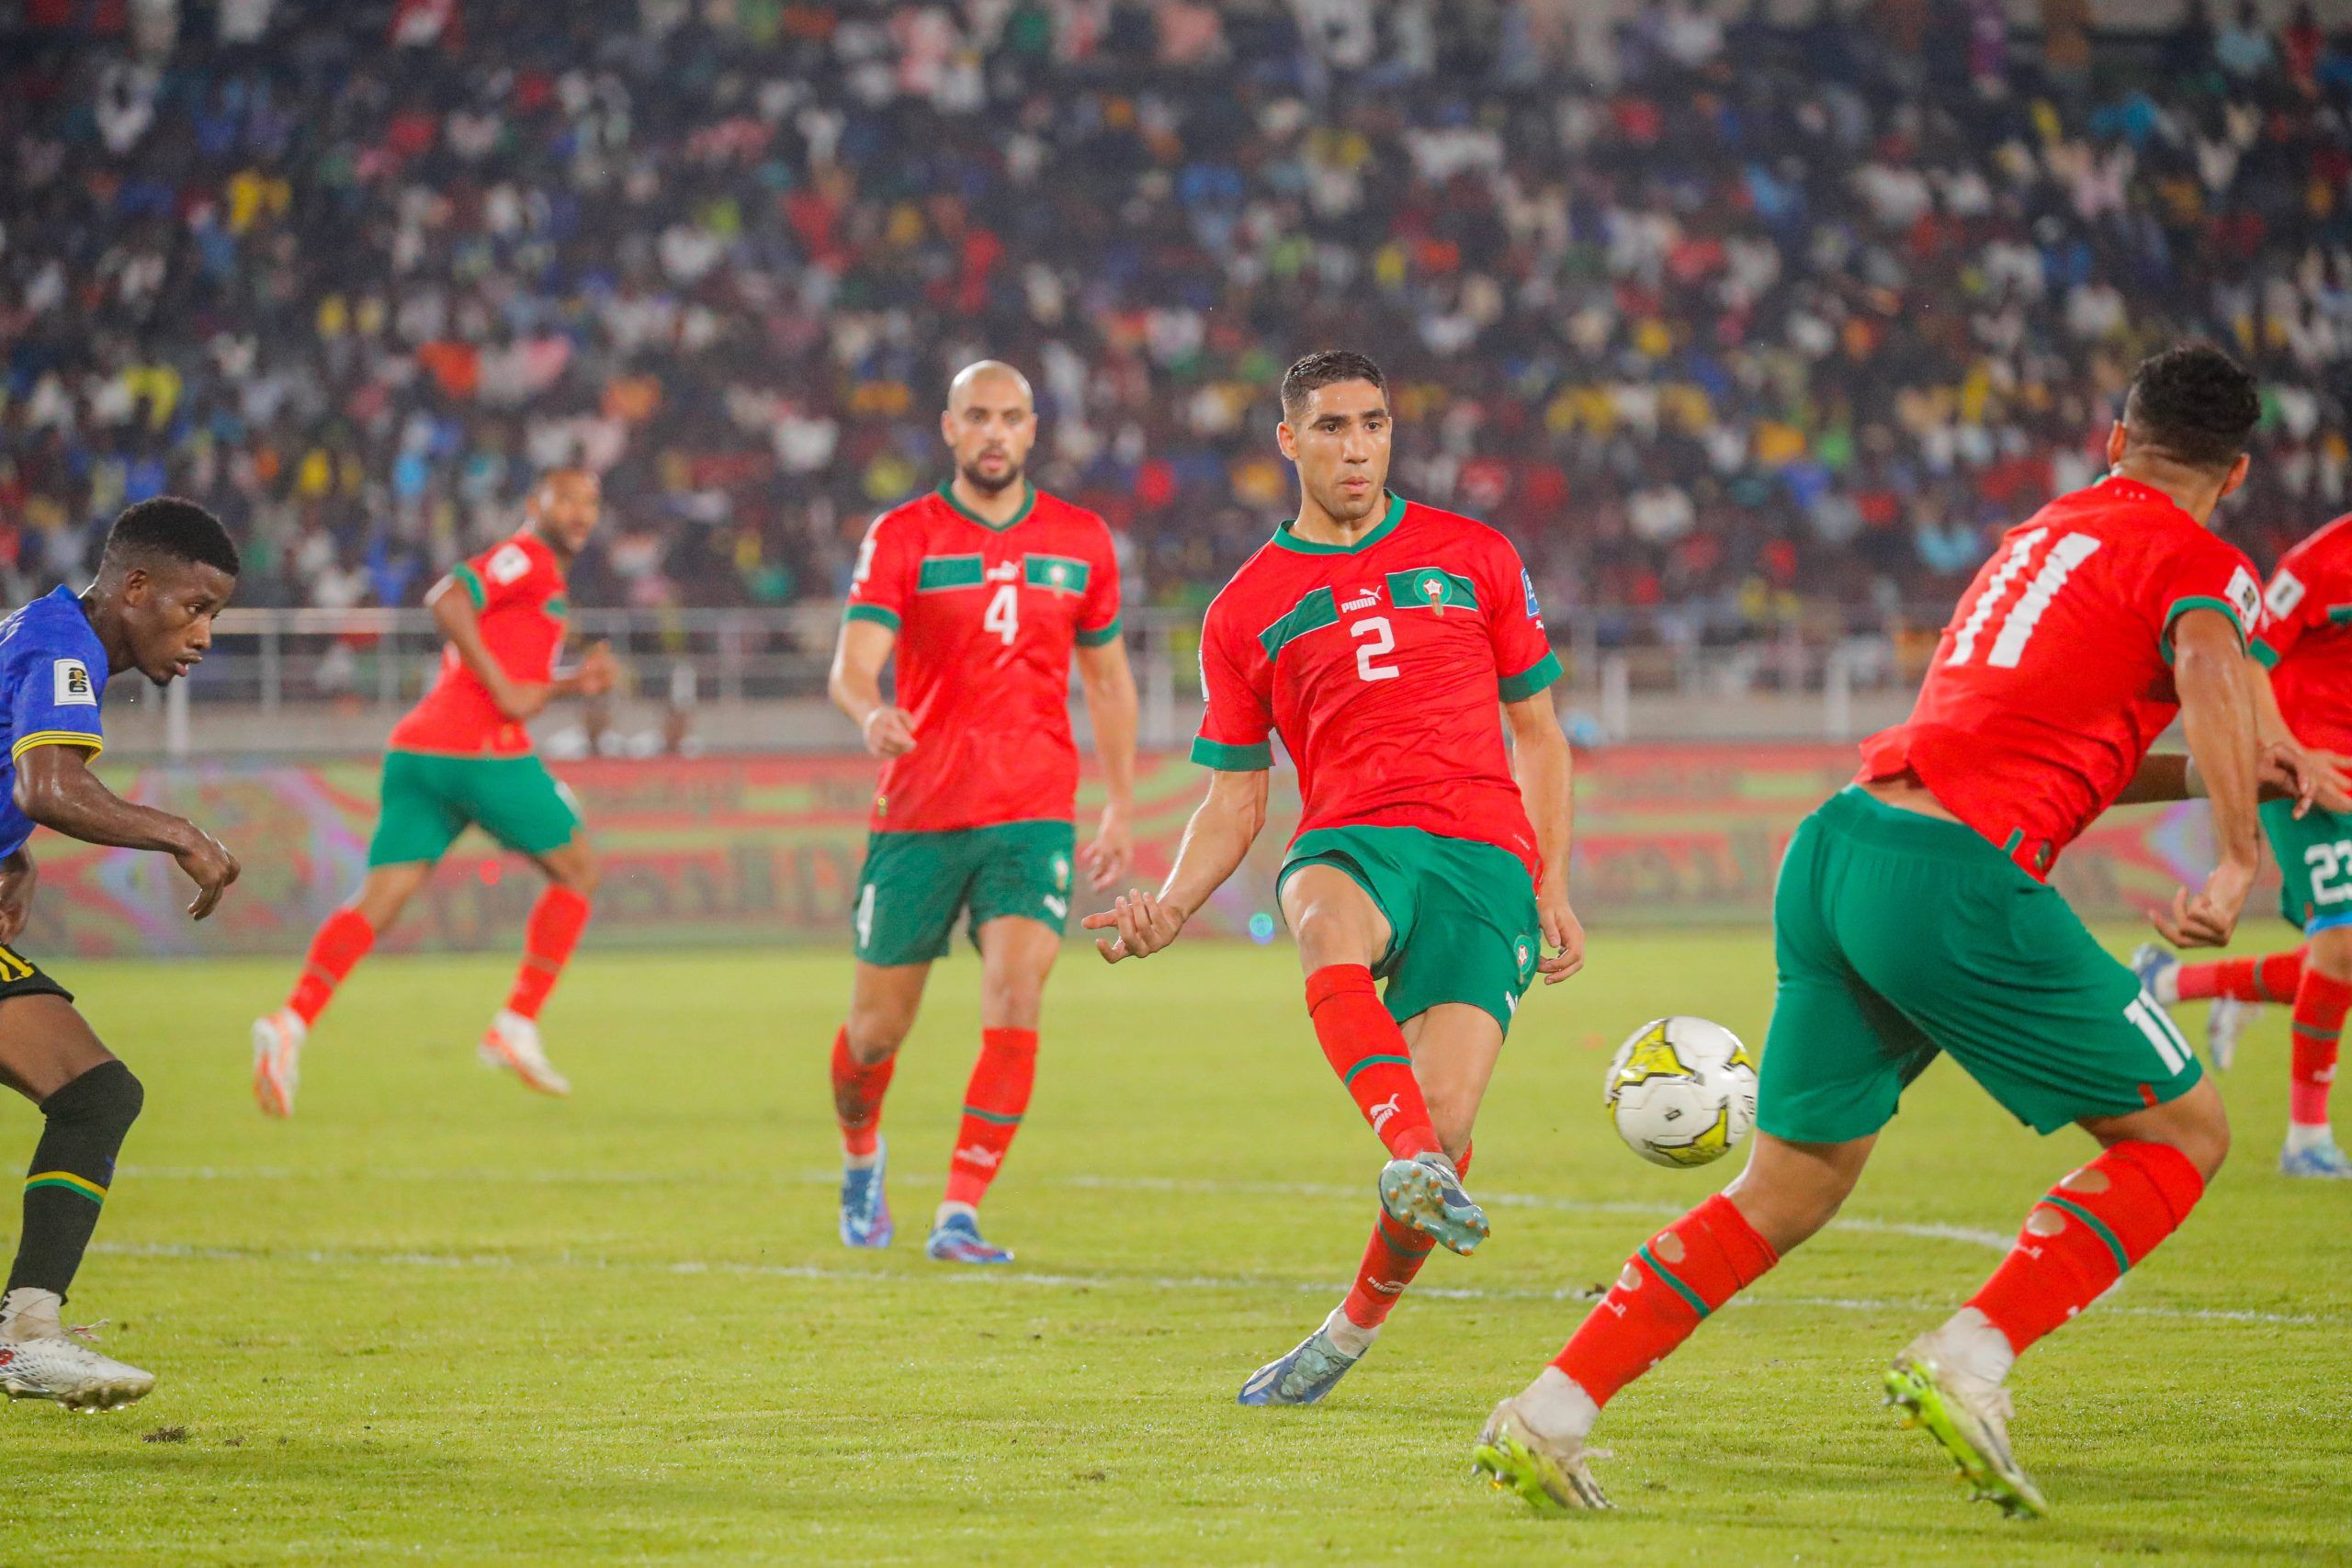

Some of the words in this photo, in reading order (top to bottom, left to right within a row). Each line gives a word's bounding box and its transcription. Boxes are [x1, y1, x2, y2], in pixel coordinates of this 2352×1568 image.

[983, 582, 1019, 646] 4
[1341, 596, 1376, 614] PUMA
[1945, 526, 2101, 669] 11
[1350, 615, 1400, 682] 2
[2123, 987, 2193, 1077] 11
